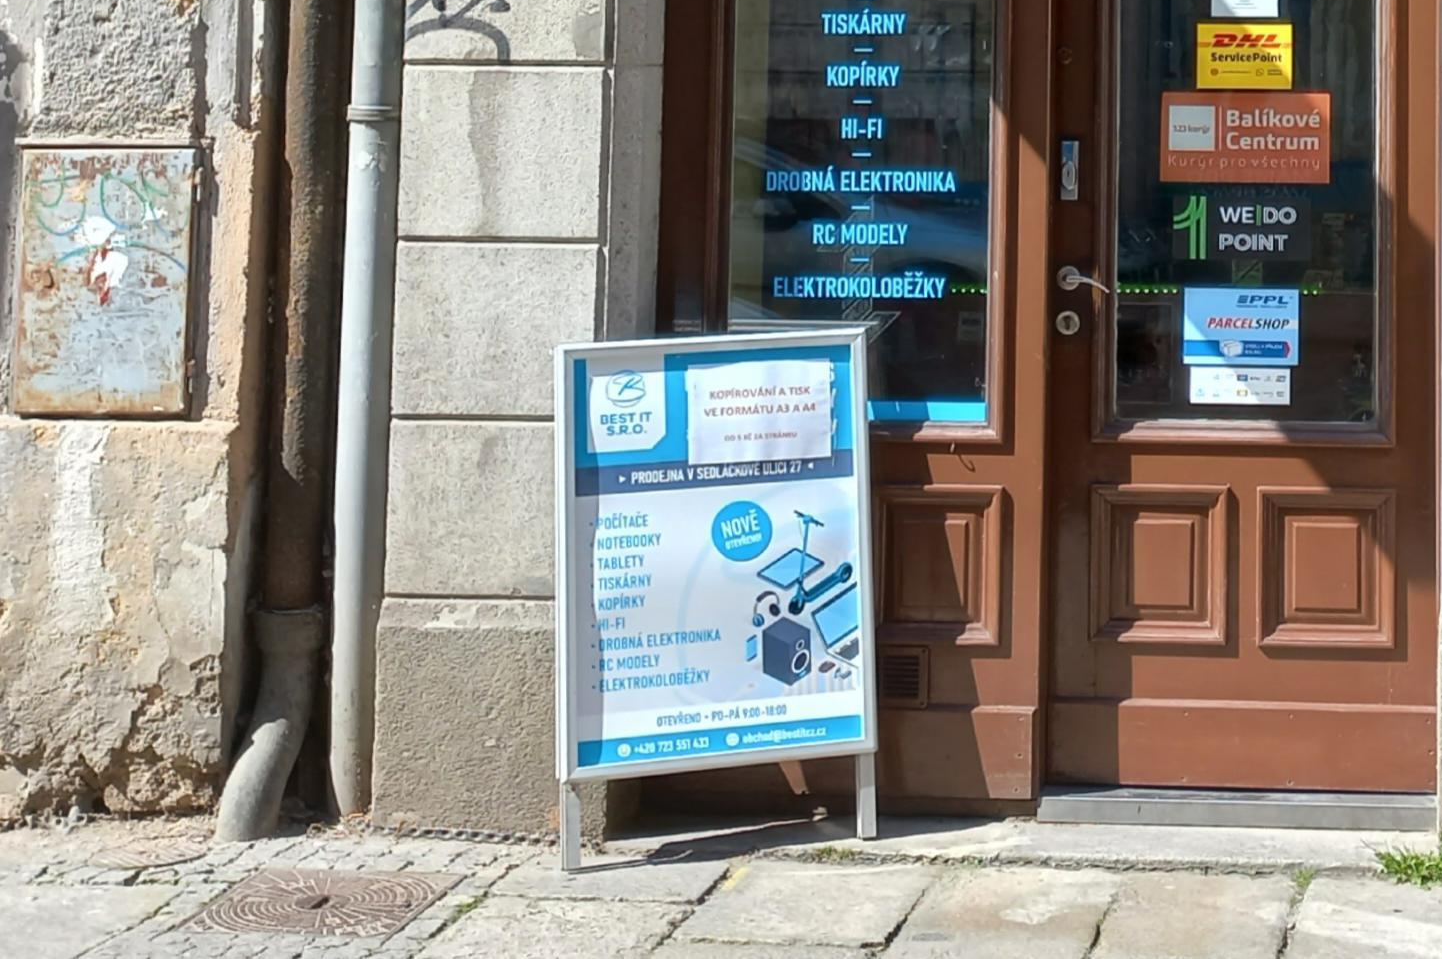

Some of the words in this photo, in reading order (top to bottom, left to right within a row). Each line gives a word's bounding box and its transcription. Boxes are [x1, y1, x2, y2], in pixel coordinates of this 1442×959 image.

[821, 9, 907, 35] TISKÁRNY
[1212, 33, 1282, 48] DHL
[1210, 52, 1282, 62] ServicePoint
[826, 60, 900, 87] KOPÍRKY
[1226, 108, 1321, 128] Balíkové
[841, 118, 883, 139] HI-FI
[1225, 132, 1320, 151] Centrum
[1167, 154, 1214, 170] Kurýr
[1220, 155, 1247, 169] pro
[1251, 154, 1320, 171] všechny
[766, 165, 835, 192] DROBNÁ
[840, 170, 956, 193] ELEKTRONIKA
[812, 223, 835, 244] RC
[840, 223, 908, 245] MODELY
[1218, 233, 1289, 252] POINT
[773, 271, 946, 299] ELEKTROKOLOBĚŽKY
[1207, 317, 1290, 330] PARCELSHOP
[709, 385, 777, 401] KOPÍROVÁNÍ
[778, 387, 787, 397] A
[789, 385, 811, 396] TISK
[600, 411, 637, 425] BEST
[640, 410, 653, 423] IT
[704, 408, 719, 418] VE
[720, 402, 774, 417] FORMÁTU
[775, 403, 790, 414] A3
[792, 403, 800, 413] A
[802, 402, 816, 412] A4
[631, 468, 685, 484] PRODEJNA
[687, 467, 695, 481] V
[763, 461, 788, 475] ULICI
[789, 460, 802, 473] 27
[595, 511, 649, 530] POČÍTAČE
[720, 509, 761, 540] NOVĚ
[597, 532, 662, 551] NOTEBOOKY
[597, 554, 645, 570] TABLETY
[598, 572, 652, 591] TISKÁRNY
[598, 593, 646, 611] KOPÍRKY
[598, 617, 626, 631] HI-FI
[599, 632, 644, 652] DROBNÁ
[646, 629, 722, 648] ELEKTRONIKA
[599, 658, 614, 672] RC
[616, 654, 660, 670] MODELY
[600, 668, 711, 693] ELEKTROKOLOBĚŽKY
[656, 711, 701, 727] OTEVŘENO
